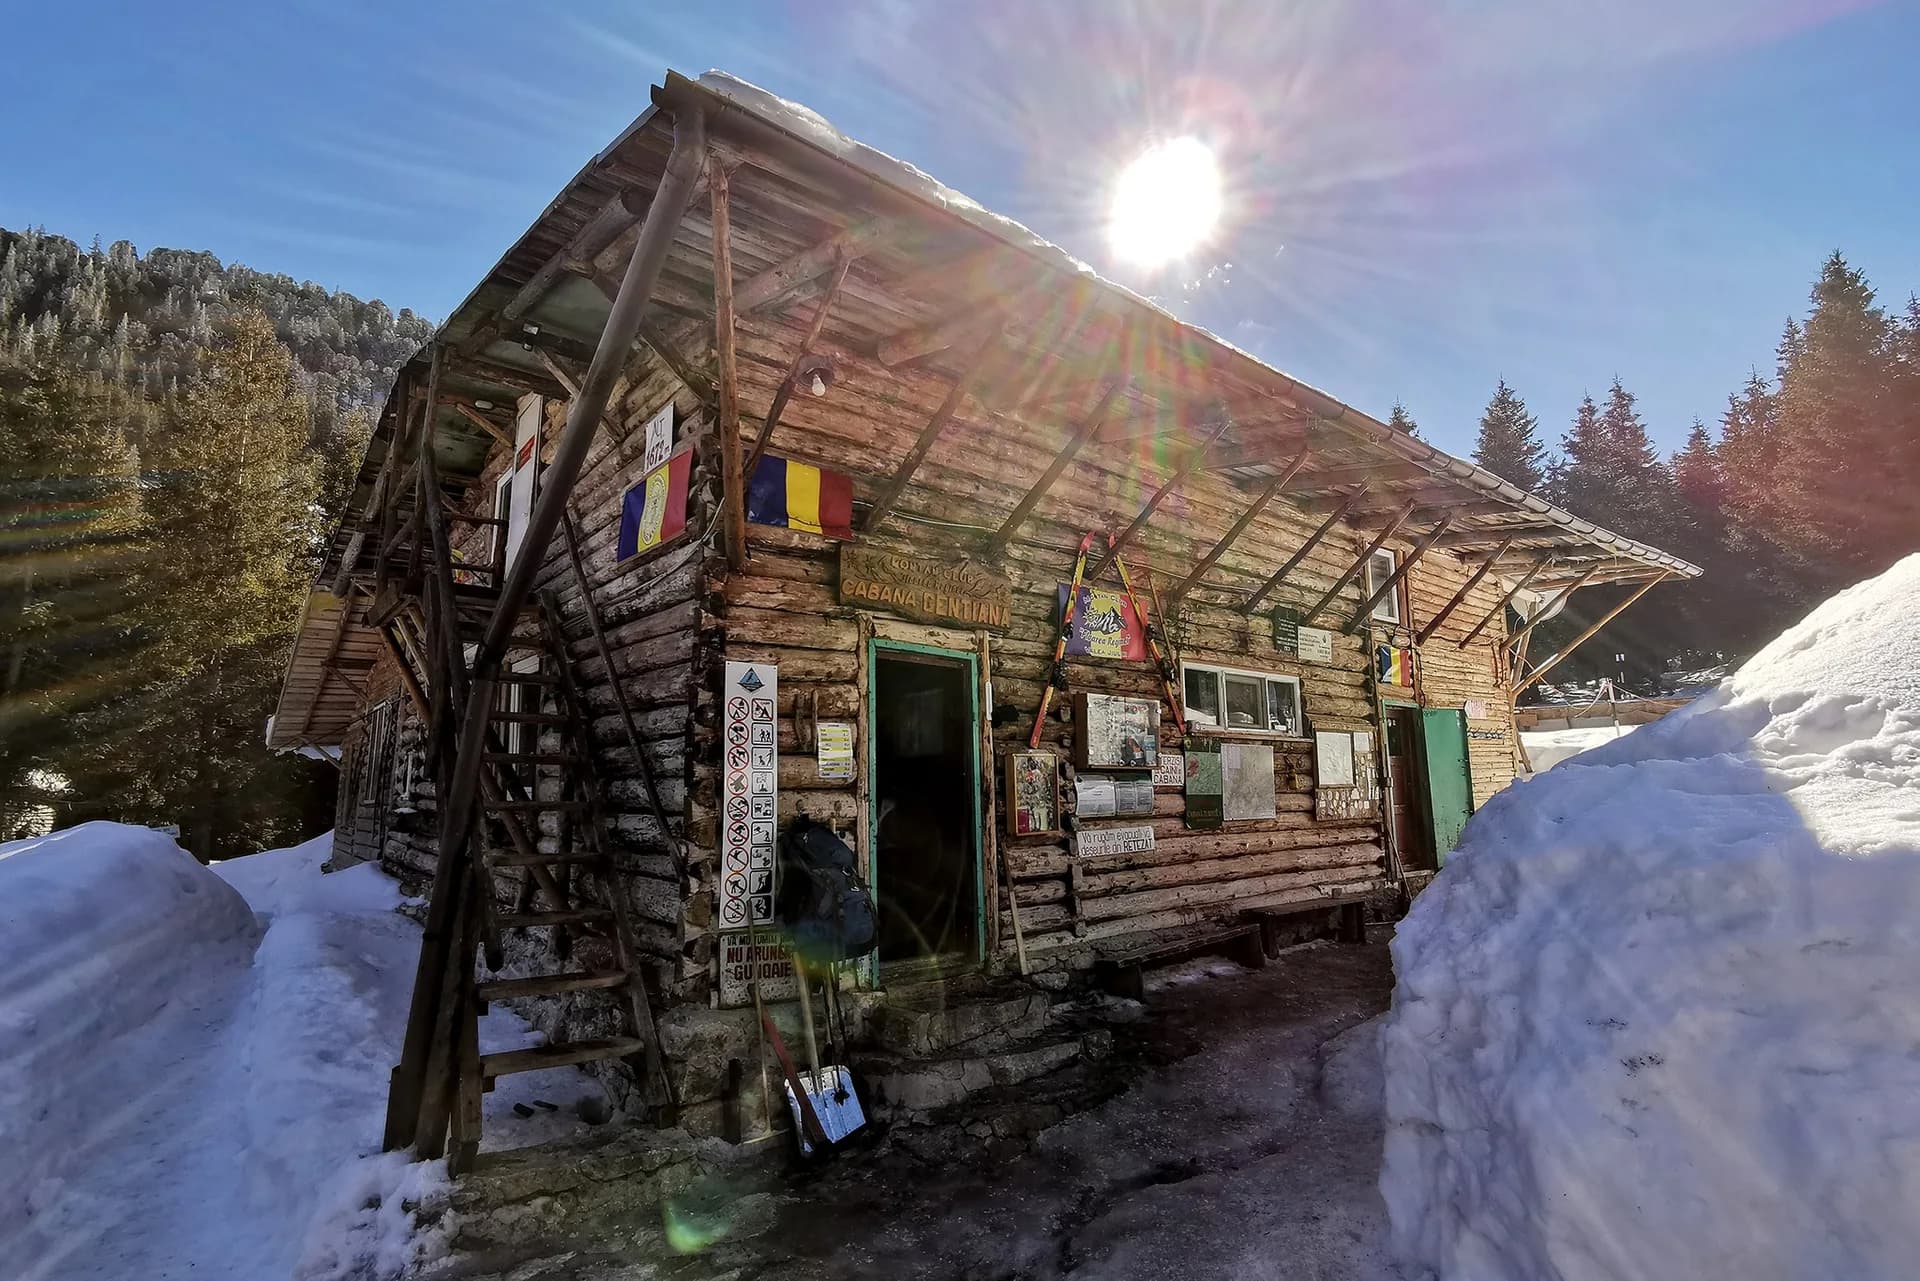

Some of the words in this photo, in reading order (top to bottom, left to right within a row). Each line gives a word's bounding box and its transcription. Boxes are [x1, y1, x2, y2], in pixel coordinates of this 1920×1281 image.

[943, 567, 975, 584] CLUB
[841, 578, 917, 607] CABANA
[922, 591, 1011, 629] GENTIANA
[1153, 774, 1182, 785] CABANA
[1123, 838, 1153, 851] RETEZAT
[727, 946, 743, 963] NU
